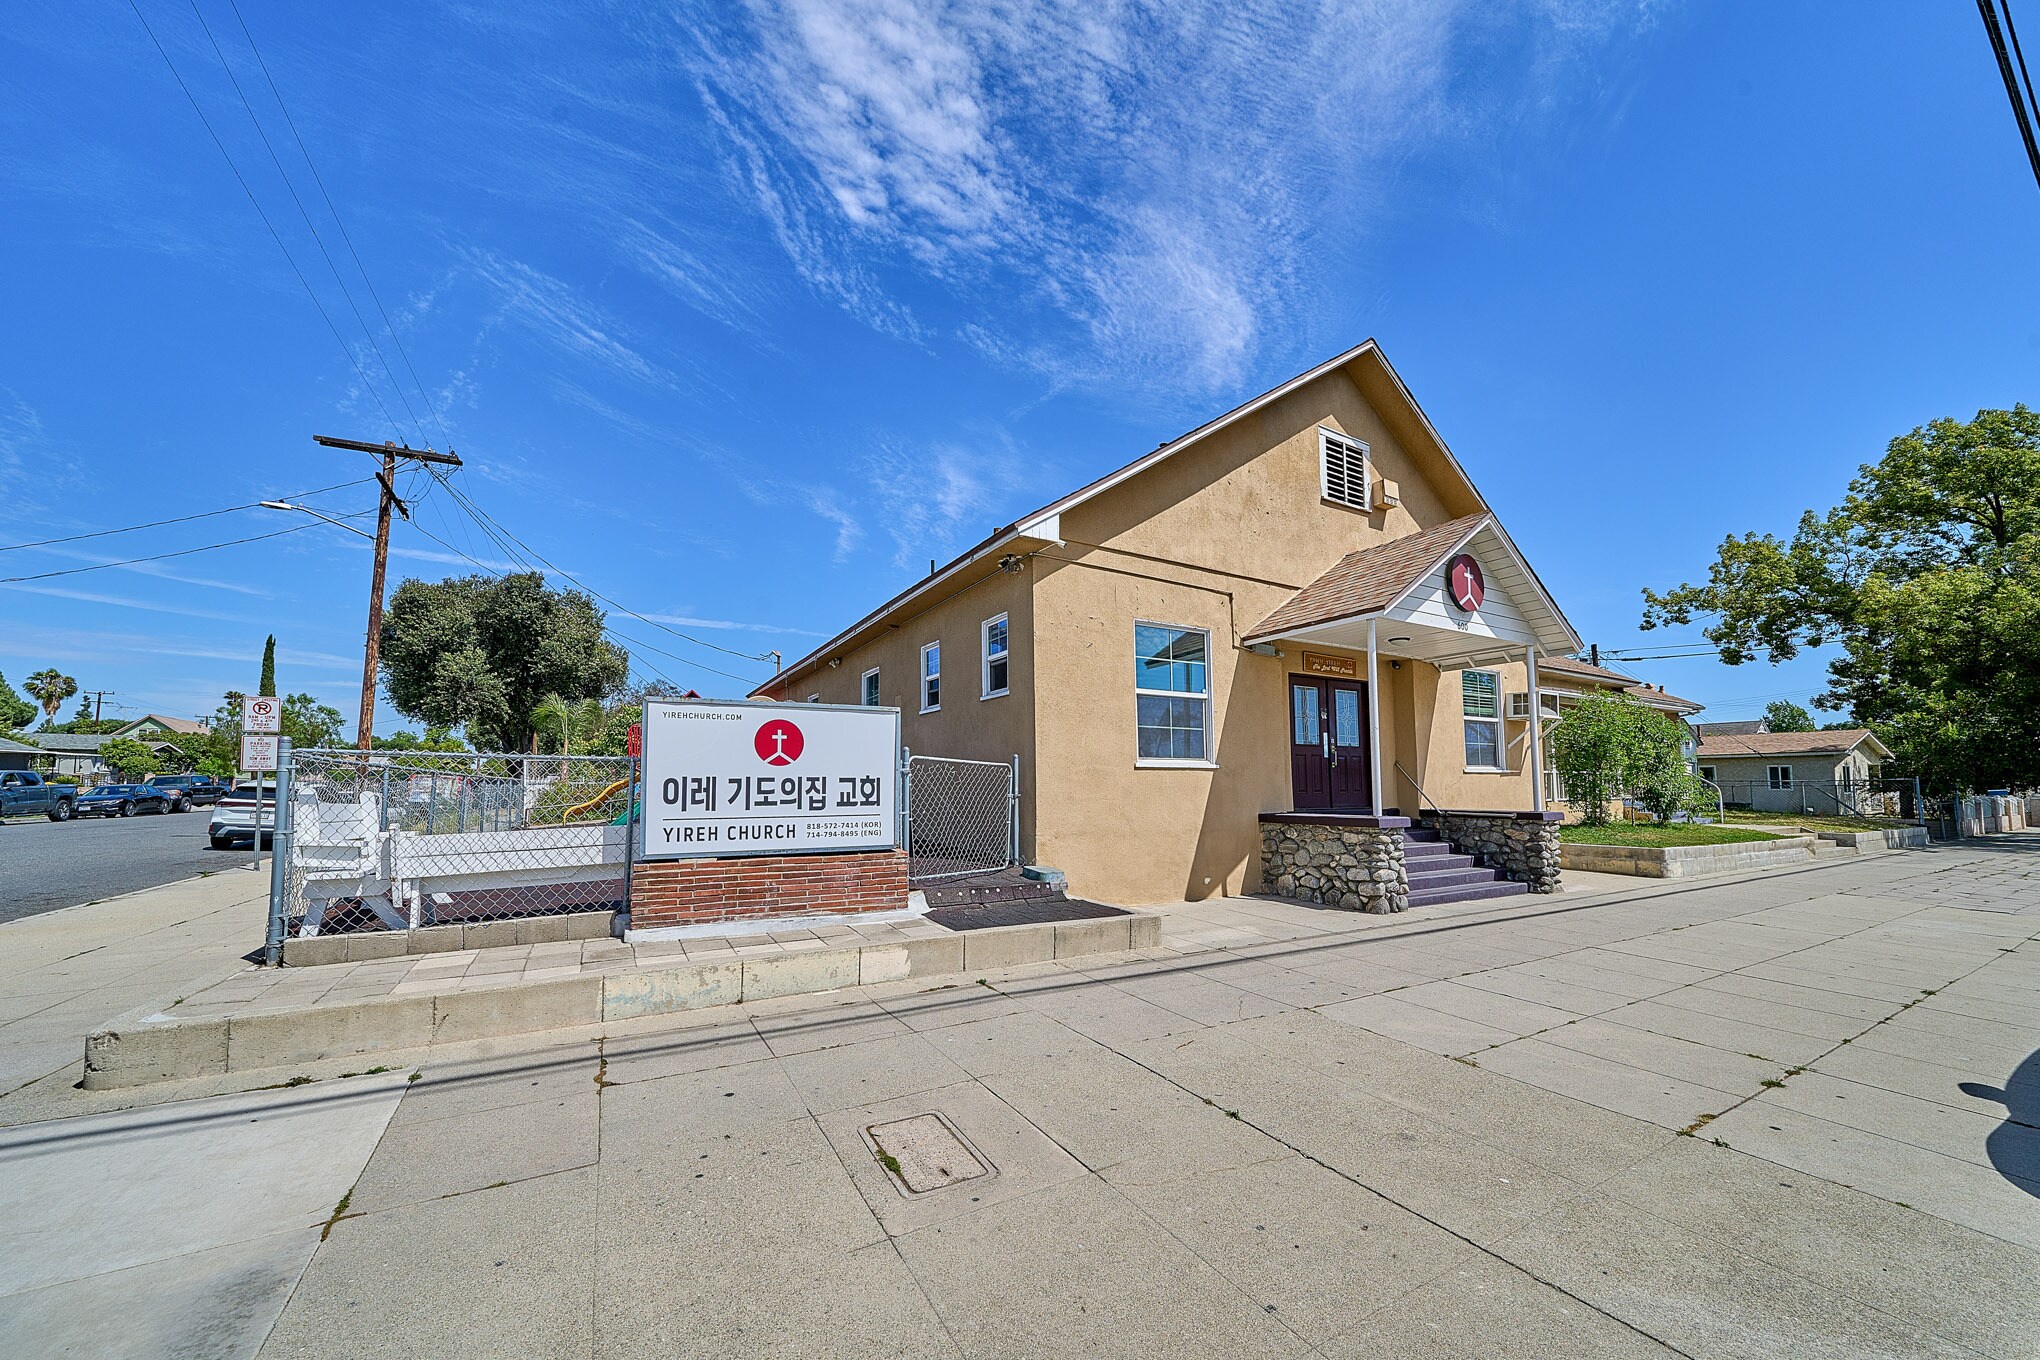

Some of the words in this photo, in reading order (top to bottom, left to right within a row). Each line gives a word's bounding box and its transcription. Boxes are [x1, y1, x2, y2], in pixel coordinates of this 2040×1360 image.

[662, 711, 742, 720] YIREHCHURCH.COM
[662, 776, 717, 812] 이레
[728, 776, 827, 811] 기도의집
[836, 775, 881, 807] 교회
[806, 822, 859, 830] 818-572-7414
[861, 821, 882, 829] (KOR)
[662, 826, 718, 842] YIREH
[727, 824, 796, 841] CHURCH
[860, 829, 882, 837] (ENG)
